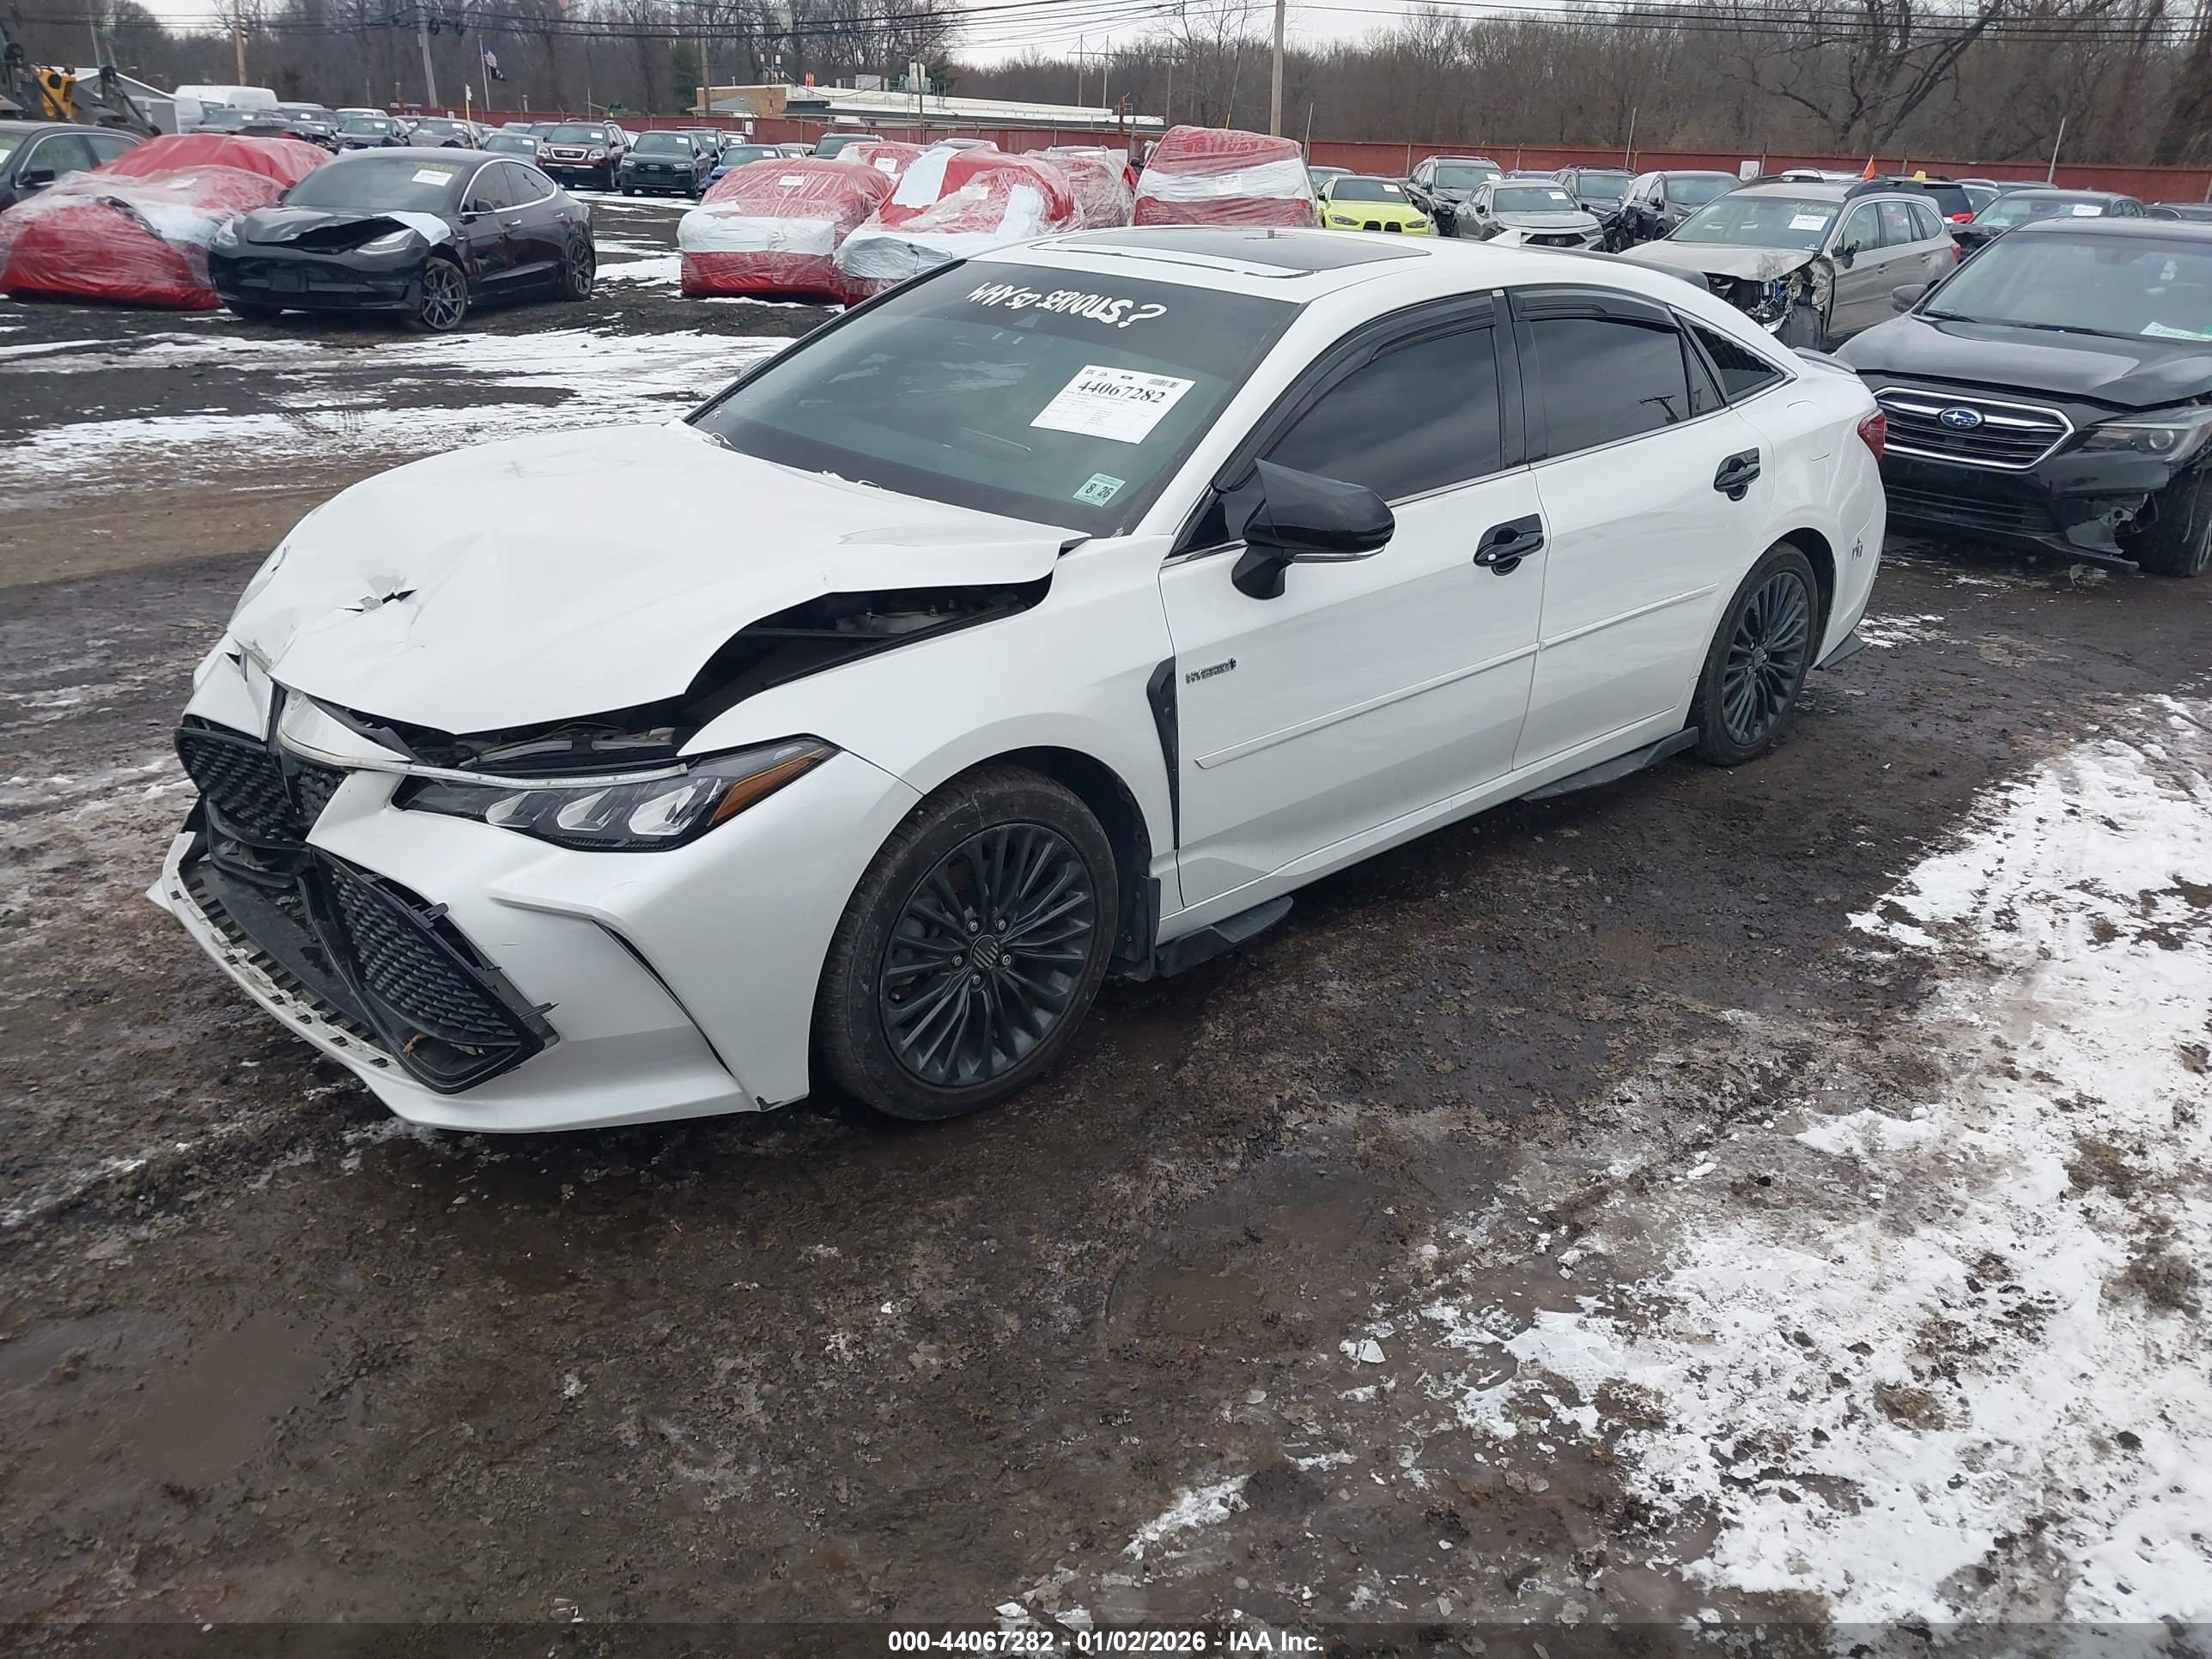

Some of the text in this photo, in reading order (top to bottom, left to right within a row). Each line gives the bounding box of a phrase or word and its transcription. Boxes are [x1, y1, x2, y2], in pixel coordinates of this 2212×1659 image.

[965, 282, 1031, 307] WHY
[1005, 292, 1042, 310] SO
[1077, 380, 1167, 404] 44067282
[1085, 483, 1115, 498] 8 26
